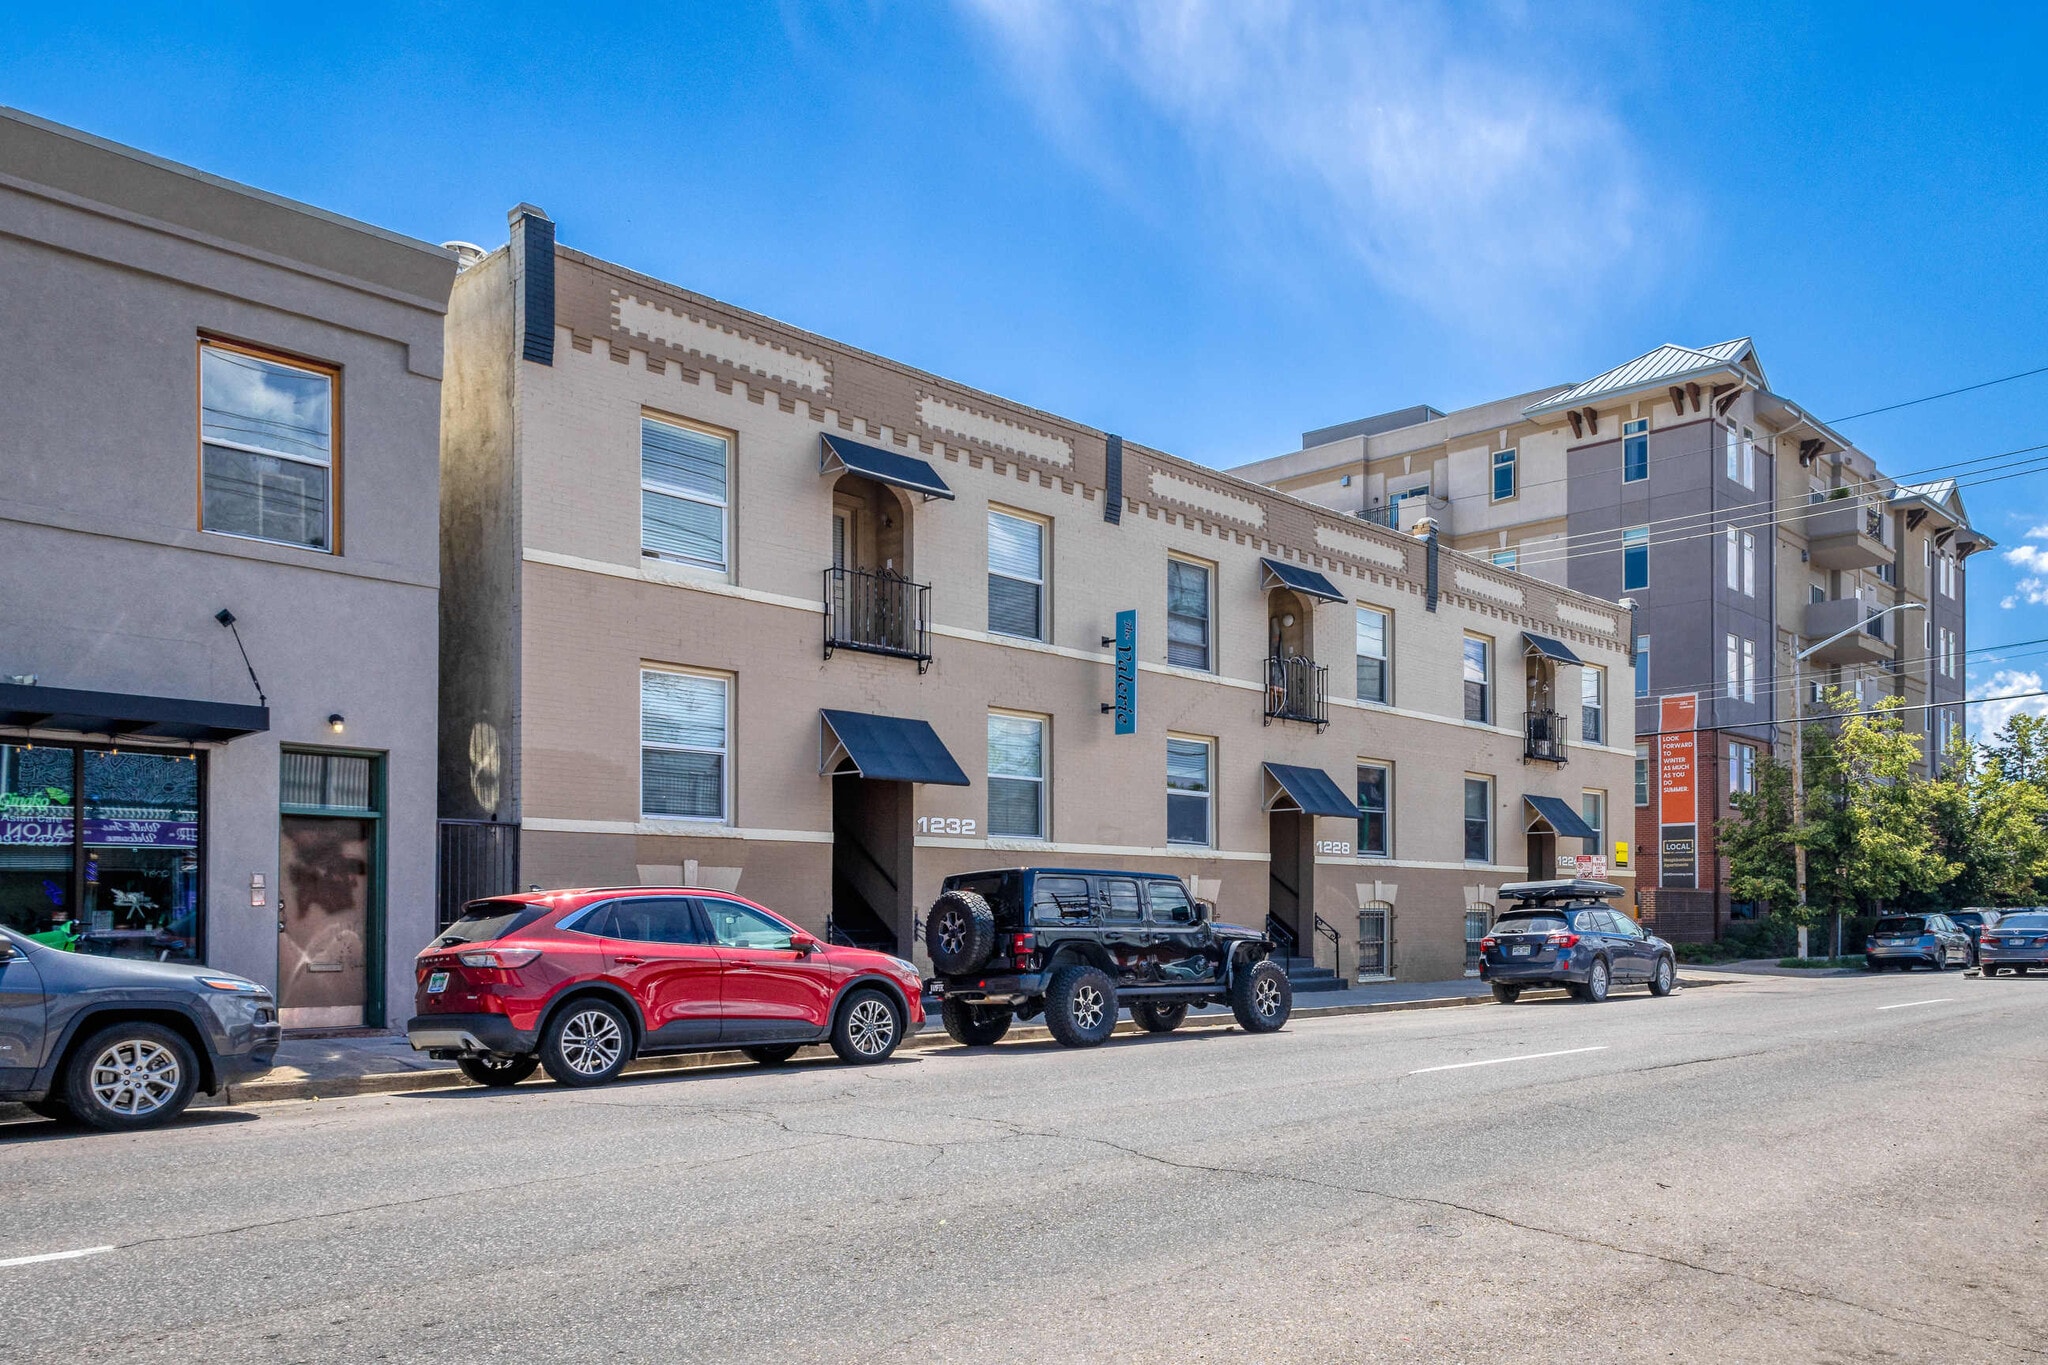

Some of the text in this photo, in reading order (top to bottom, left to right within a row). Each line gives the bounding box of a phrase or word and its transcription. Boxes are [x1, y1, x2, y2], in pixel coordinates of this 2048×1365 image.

[1117, 645, 1134, 724] Valerie
[1, 814, 63, 824] Asian Cafe
[917, 816, 977, 835] 1232
[1316, 840, 1350, 854] 1228
[1557, 855, 1576, 866] 122
